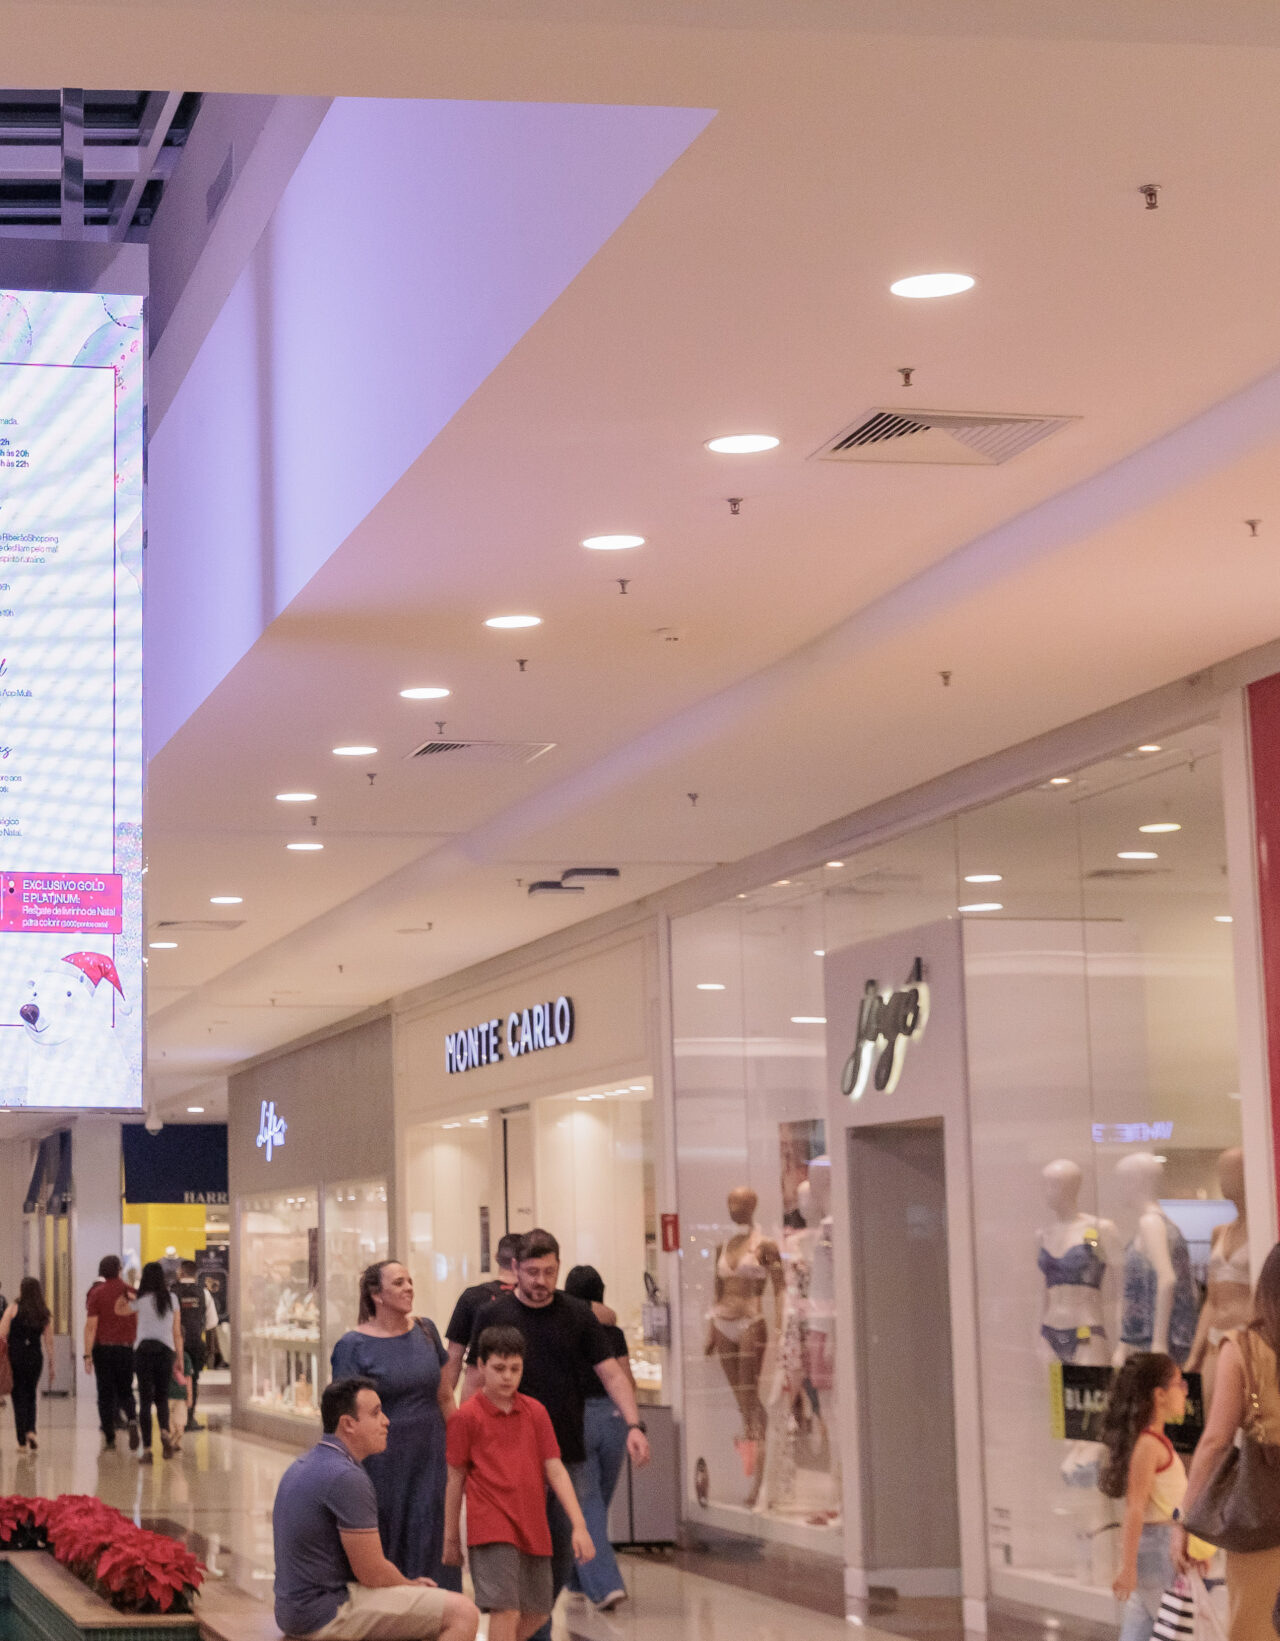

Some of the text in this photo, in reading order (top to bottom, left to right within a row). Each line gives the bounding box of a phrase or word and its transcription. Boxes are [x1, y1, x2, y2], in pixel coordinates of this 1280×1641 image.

[15, 449, 30, 457] 20h
[15, 460, 29, 468] 22h
[22, 880, 105, 891] EXCLUSIVO GOLD
[22, 893, 29, 903] E
[97, 907, 116, 916] Natal
[445, 996, 573, 1074] MONTE CARLO
